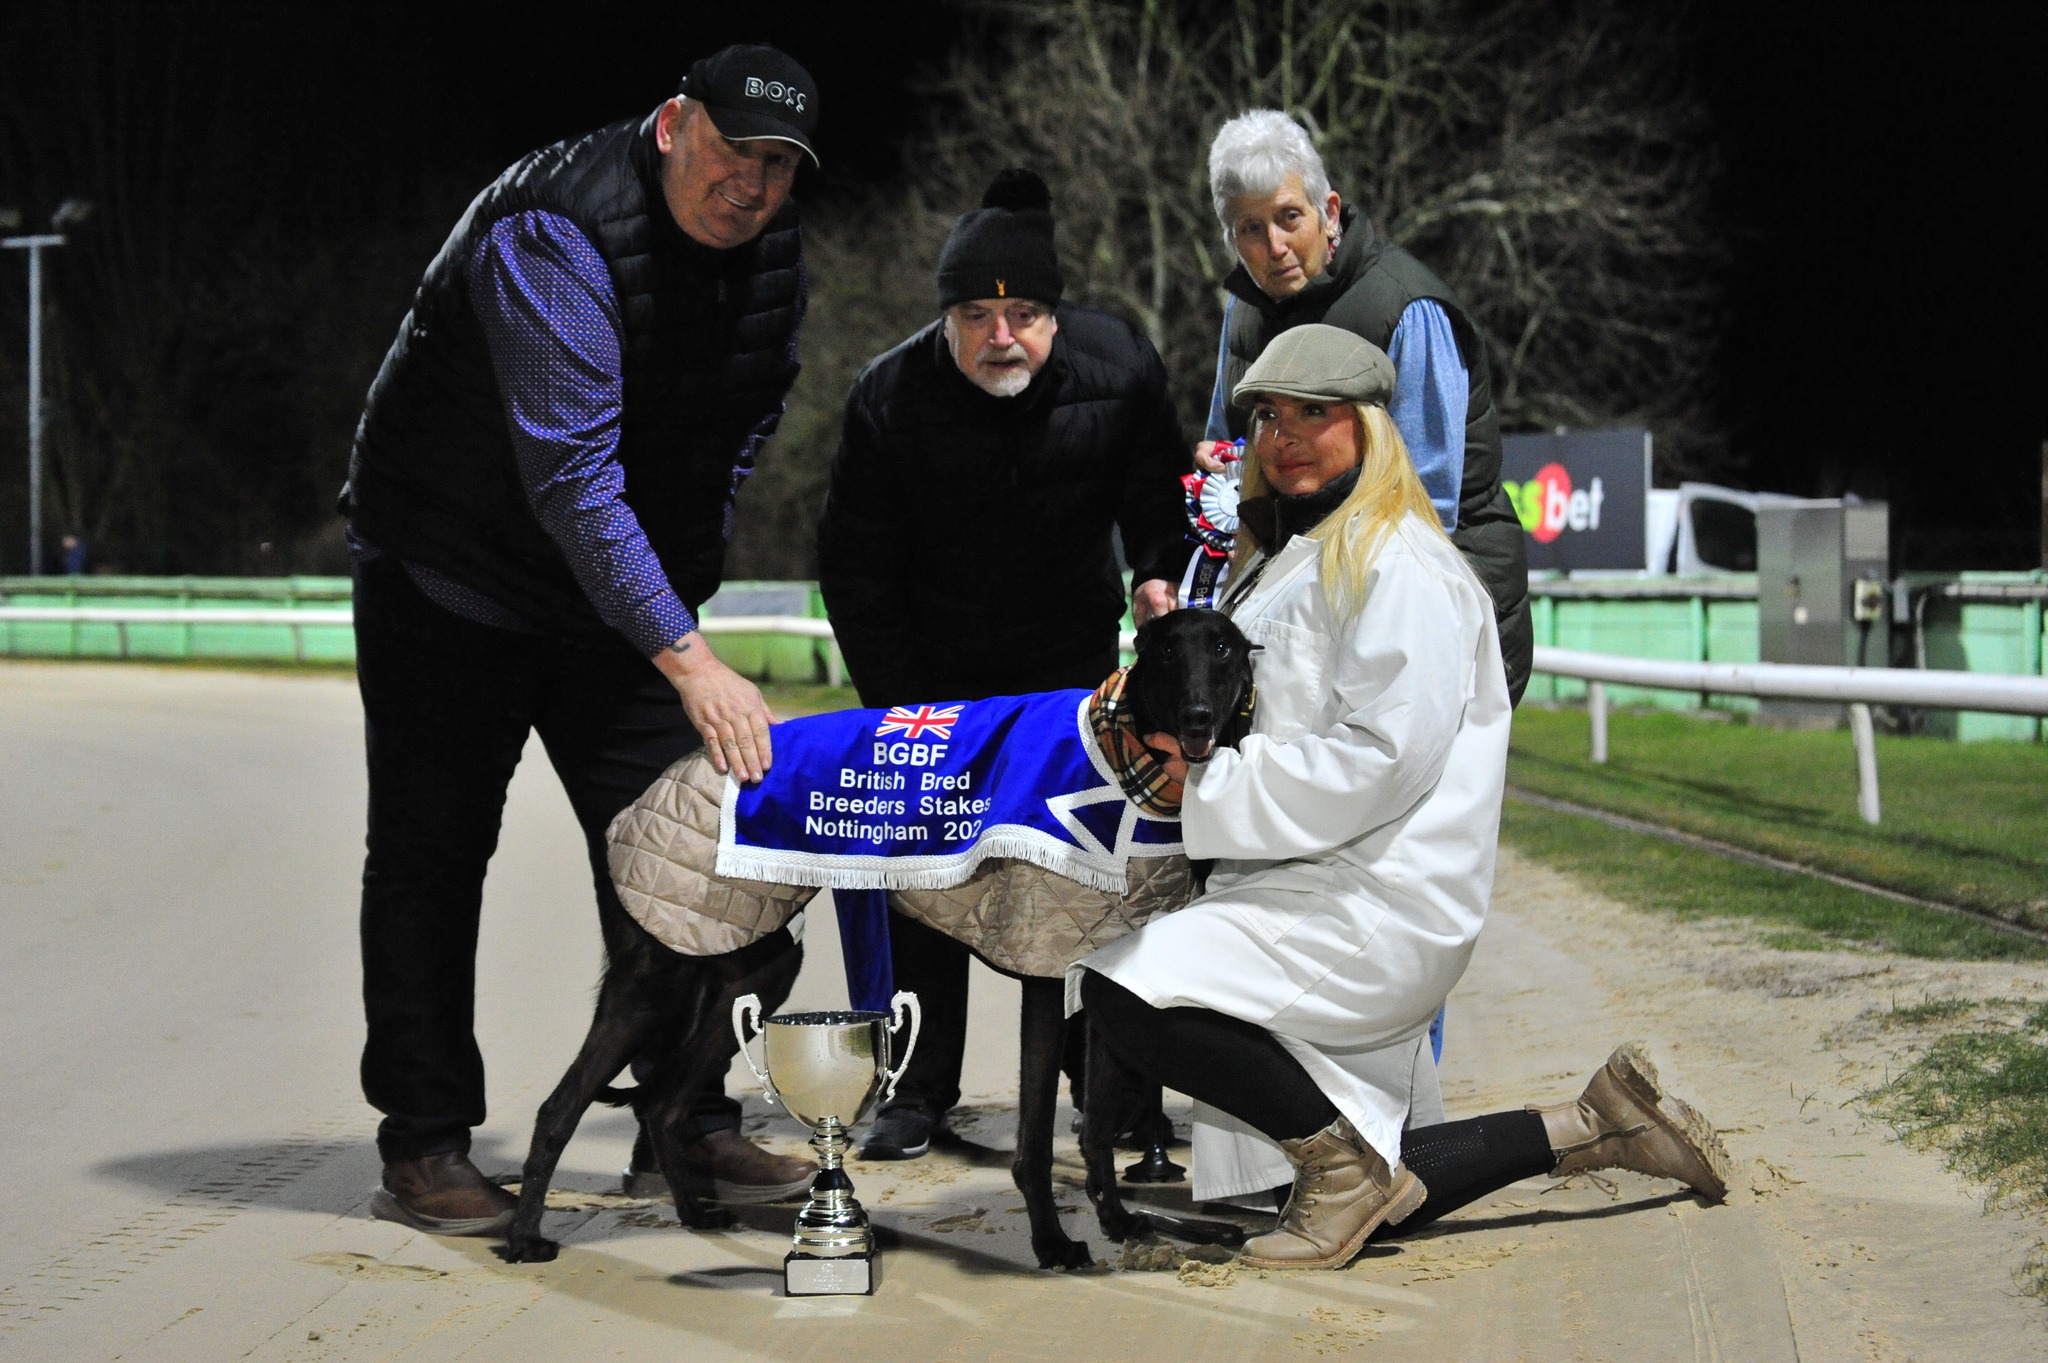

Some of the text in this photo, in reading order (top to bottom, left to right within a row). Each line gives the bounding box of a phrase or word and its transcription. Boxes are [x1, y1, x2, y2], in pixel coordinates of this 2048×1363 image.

[745, 77, 807, 113] BOSS
[873, 742, 948, 766] BGBF
[840, 768, 970, 791] British Bred
[809, 791, 991, 815] Breeders Stakes
[805, 816, 985, 844] Nottingham 202
